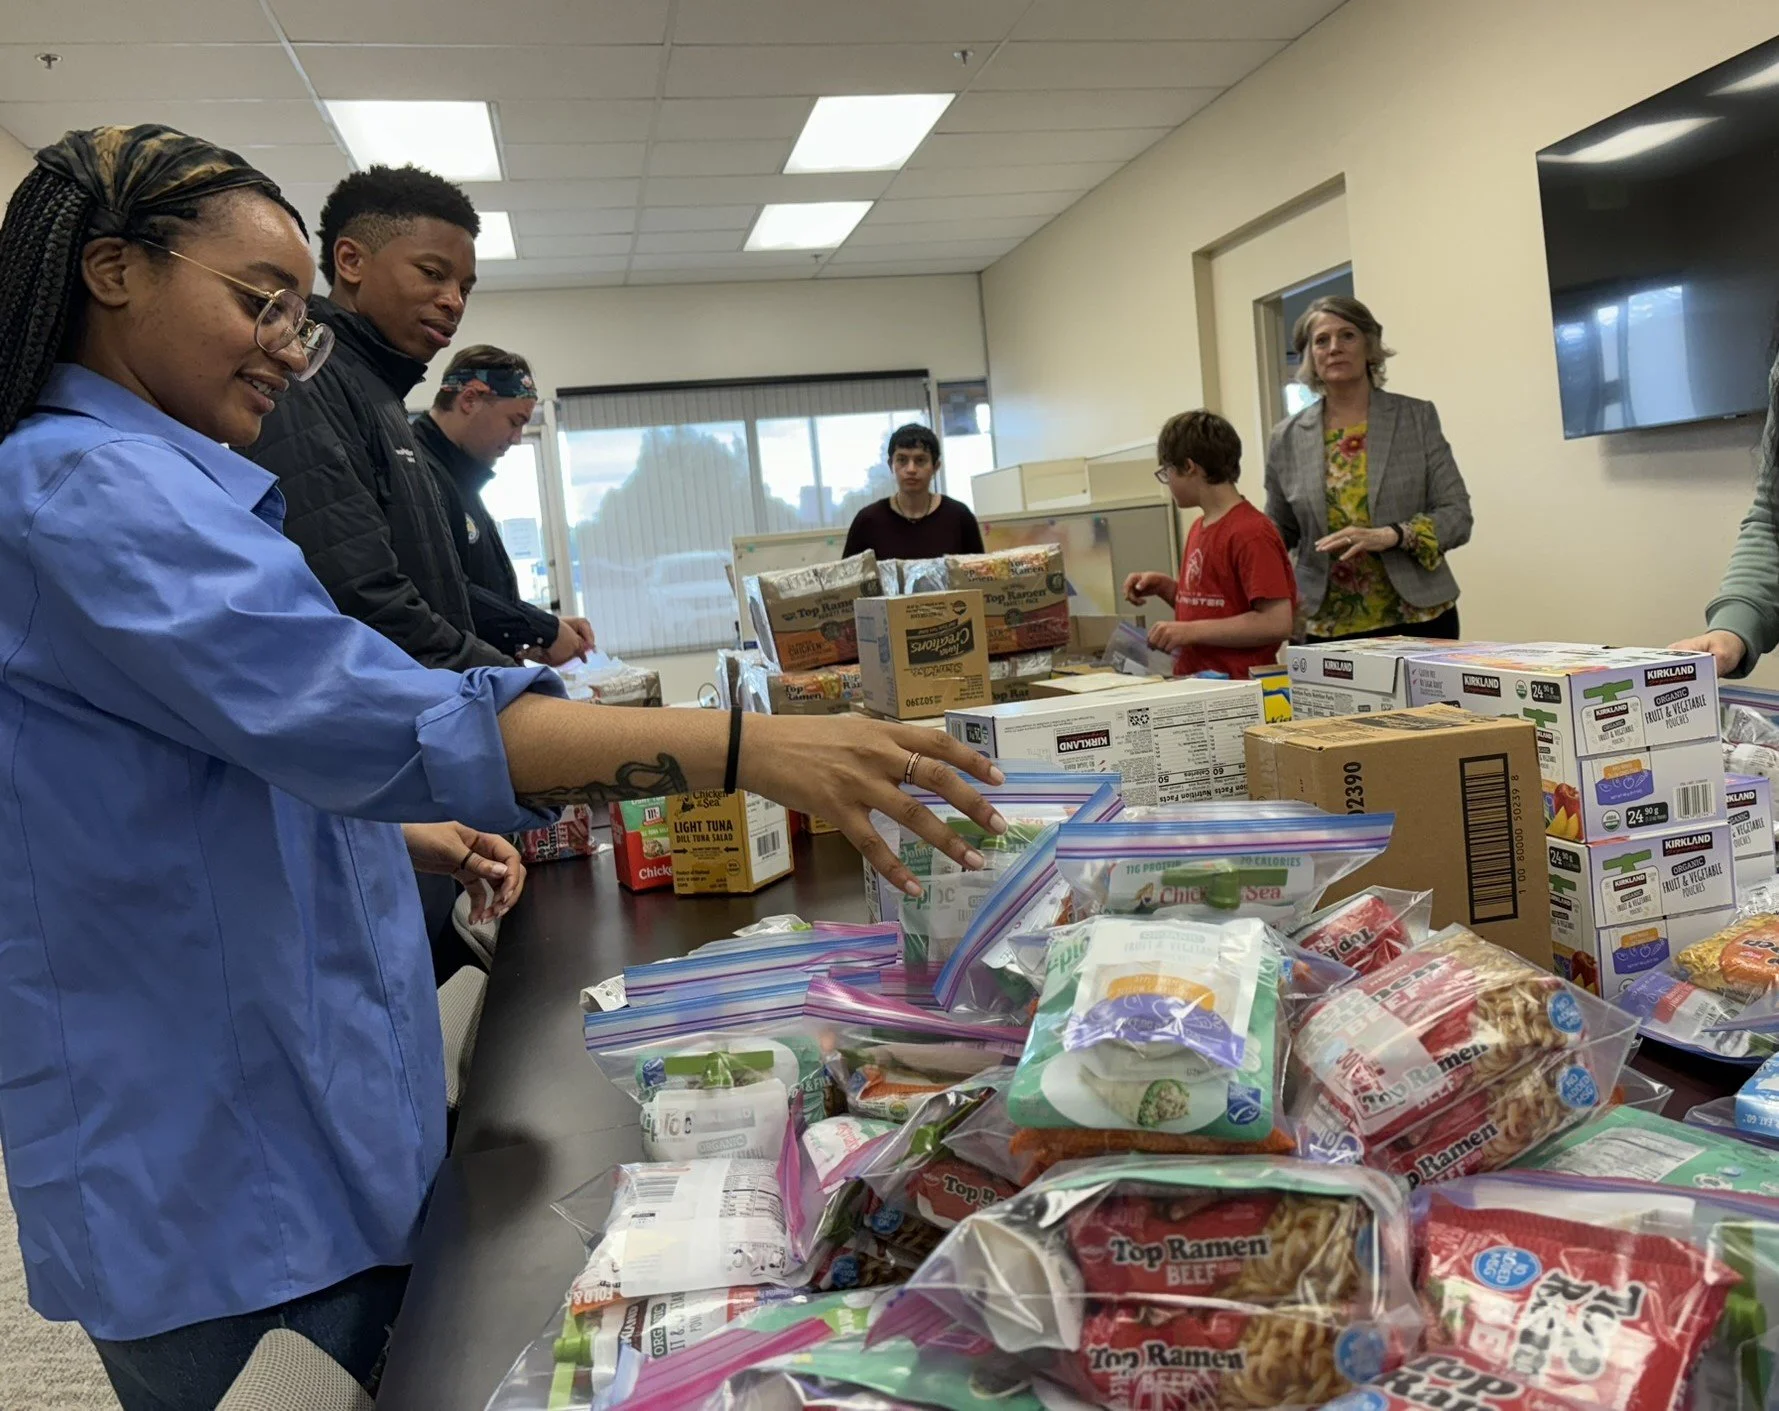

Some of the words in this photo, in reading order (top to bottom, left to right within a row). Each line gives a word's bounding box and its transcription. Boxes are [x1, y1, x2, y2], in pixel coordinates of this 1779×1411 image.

[984, 592, 1005, 604] Top
[1007, 589, 1047, 600] Ramen
[796, 605, 820, 618] Top
[911, 627, 970, 653] Creations
[940, 643, 963, 656] Tuna
[1324, 660, 1353, 673] KIRKLAND
[1647, 665, 1695, 680] KIRKLAND
[1464, 676, 1499, 689] KIRKLAND
[1532, 684, 1544, 699] 24
[1656, 688, 1688, 705] ORGANIC
[906, 695, 934, 708] 502390
[1595, 703, 1628, 717] KIRKLAND
[1645, 708, 1664, 725] FRUIT
[1665, 707, 1672, 718] &
[1673, 694, 1708, 716] VEGETABLE
[1602, 719, 1626, 732] ORGANIC
[1666, 715, 1690, 730] POUCHES
[1059, 736, 1109, 752] KIRKLAND
[1158, 775, 1170, 784] 50
[1184, 769, 1211, 778] Calories
[1213, 768, 1224, 776] 60
[1181, 789, 1212, 802] Nutrition
[1214, 786, 1234, 796] Facts
[703, 797, 720, 809] Sea
[1159, 794, 1180, 804] Facts
[1512, 788, 1522, 821] 50239
[1628, 811, 1644, 825] 24
[1654, 808, 1659, 816] g
[674, 821, 703, 834] LIGHT
[706, 819, 733, 832] TUNA
[1736, 817, 1765, 836] VEGETABLE
[676, 834, 690, 843] DILL
[693, 834, 711, 843] TUNA
[712, 833, 734, 842] SALAD
[1515, 827, 1525, 861] 80000
[1665, 834, 1711, 850] KIRKLAND
[1254, 856, 1301, 867] CALORIES
[1551, 851, 1563, 864] 24
[1673, 856, 1704, 875] ORGANIC
[1517, 868, 1526, 882] 00
[1614, 874, 1646, 887] KIRKLAND
[1662, 878, 1681, 894] FRUIT
[1682, 876, 1689, 888] &
[1689, 863, 1723, 885] VEGETABLE
[1245, 885, 1281, 901] Sea
[1621, 889, 1643, 901] ORGANIC
[1682, 883, 1706, 899] POUCHES
[1403, 1043, 1489, 1098] Ramen
[805, 1081, 813, 1092] &
[1566, 1073, 1579, 1087] NO
[1567, 1075, 1591, 1100] ADDED
[1577, 1087, 1594, 1104] MSG
[1416, 1123, 1499, 1180] Ramen
[944, 1175, 978, 1204] Top
[980, 1186, 1005, 1206] R
[1110, 1237, 1163, 1265] Top
[1165, 1234, 1271, 1262] Ramen
[1483, 1251, 1501, 1279] MSG
[1166, 1264, 1218, 1286] BEEF
[652, 1304, 666, 1356] ORGNIC
[1088, 1347, 1139, 1376] Top
[1145, 1342, 1246, 1371] Ramen
